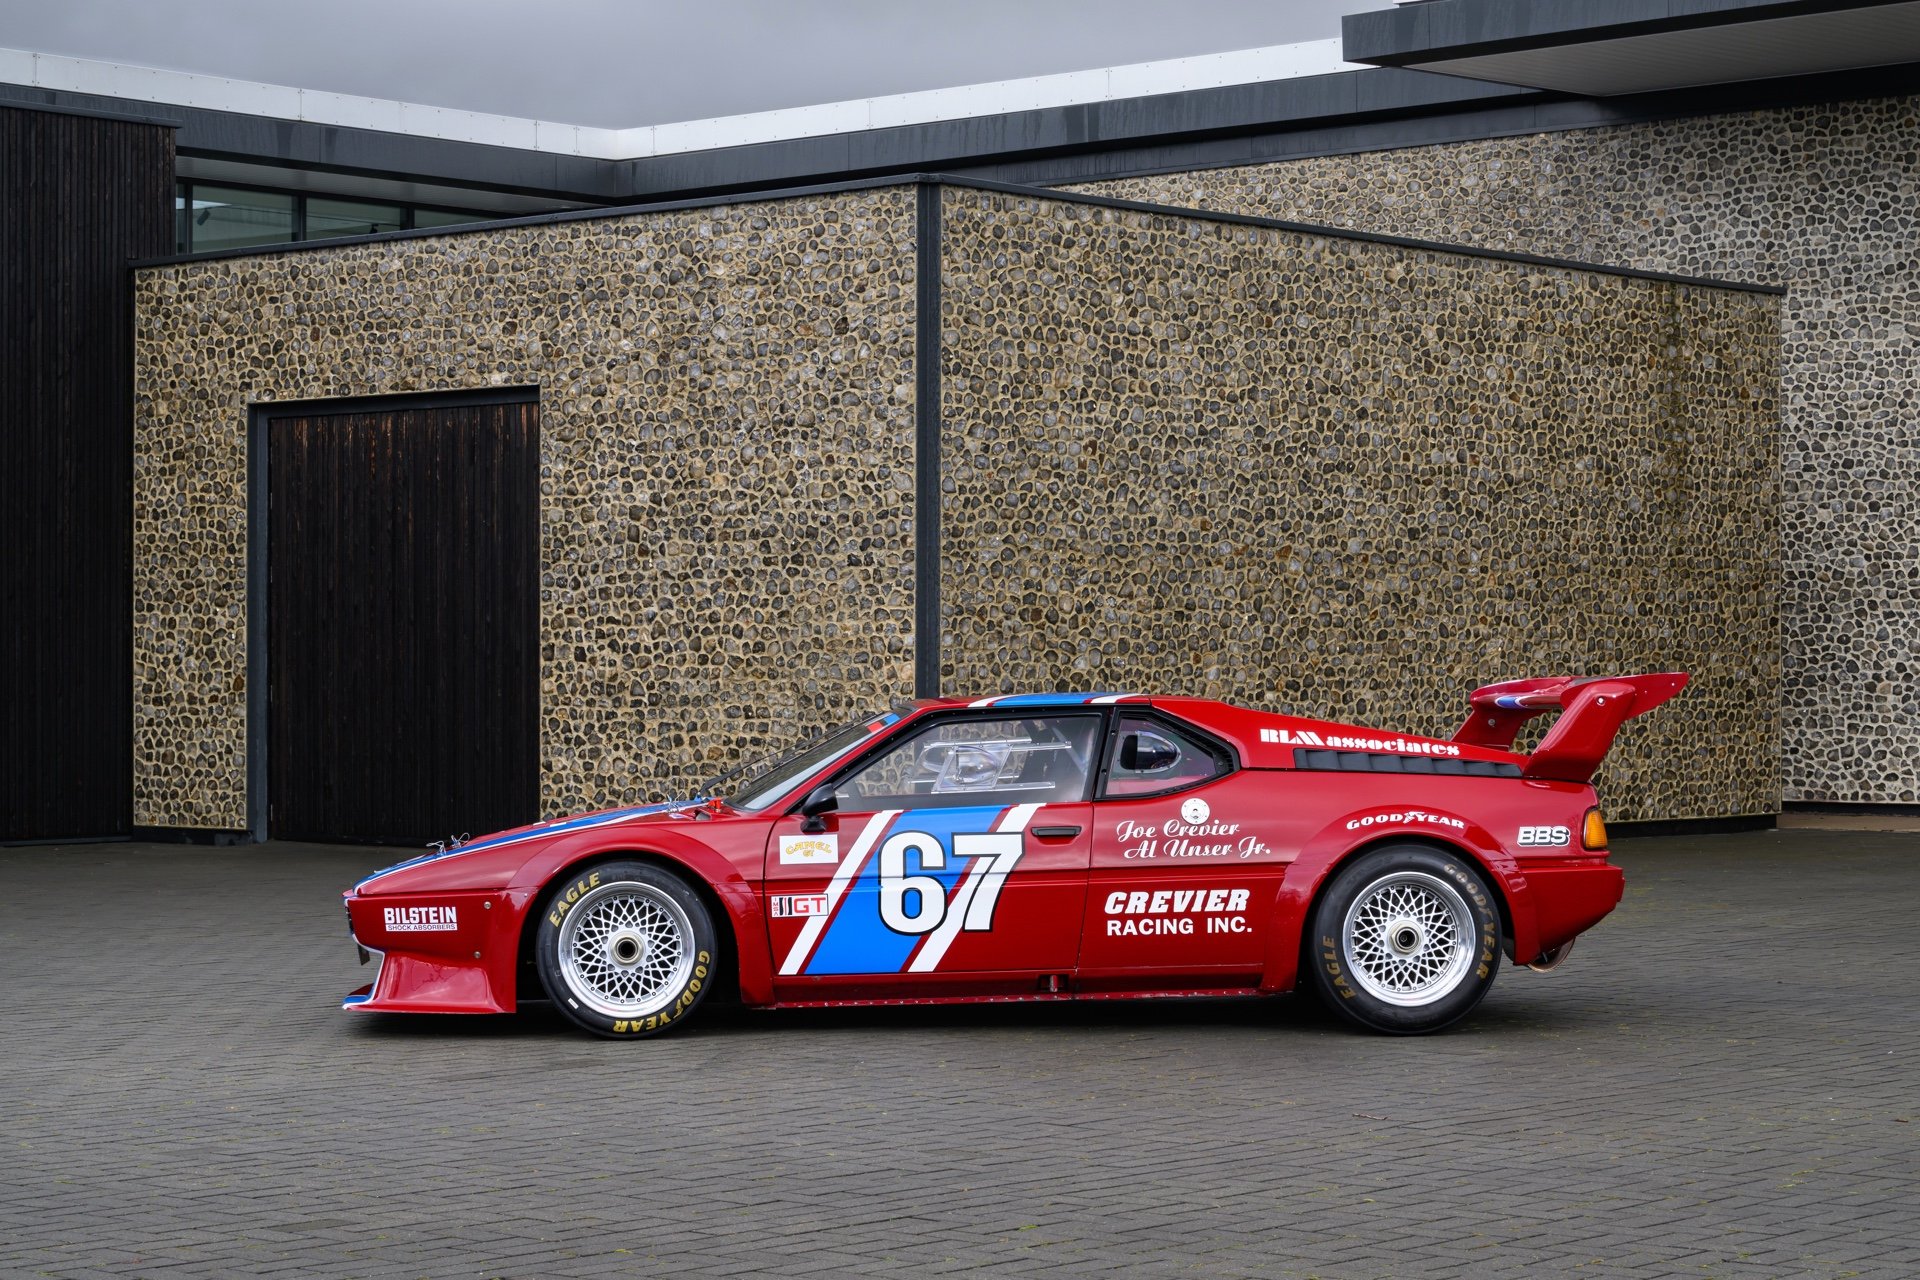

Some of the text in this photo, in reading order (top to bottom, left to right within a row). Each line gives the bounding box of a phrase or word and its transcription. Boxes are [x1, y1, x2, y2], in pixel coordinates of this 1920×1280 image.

[1326, 735, 1460, 756] associates
[1116, 819, 1240, 842] Joe Crevier
[1346, 811, 1465, 830] GOODYEAR
[1517, 826, 1571, 846] BBS
[785, 841, 832, 854] CAMEL
[1124, 836, 1271, 859] Al Unser Jr.
[878, 830, 1025, 936] 67
[549, 872, 601, 928] EAGLE
[793, 897, 826, 913] GT
[1104, 889, 1250, 915] CREVIER
[383, 906, 457, 924] BILSTEIN
[413, 923, 456, 931] ABSORBERS
[1107, 916, 1253, 936] RACING INC.
[1322, 936, 1357, 1000] EAGLE
[613, 950, 712, 1033] GOODYEAR
